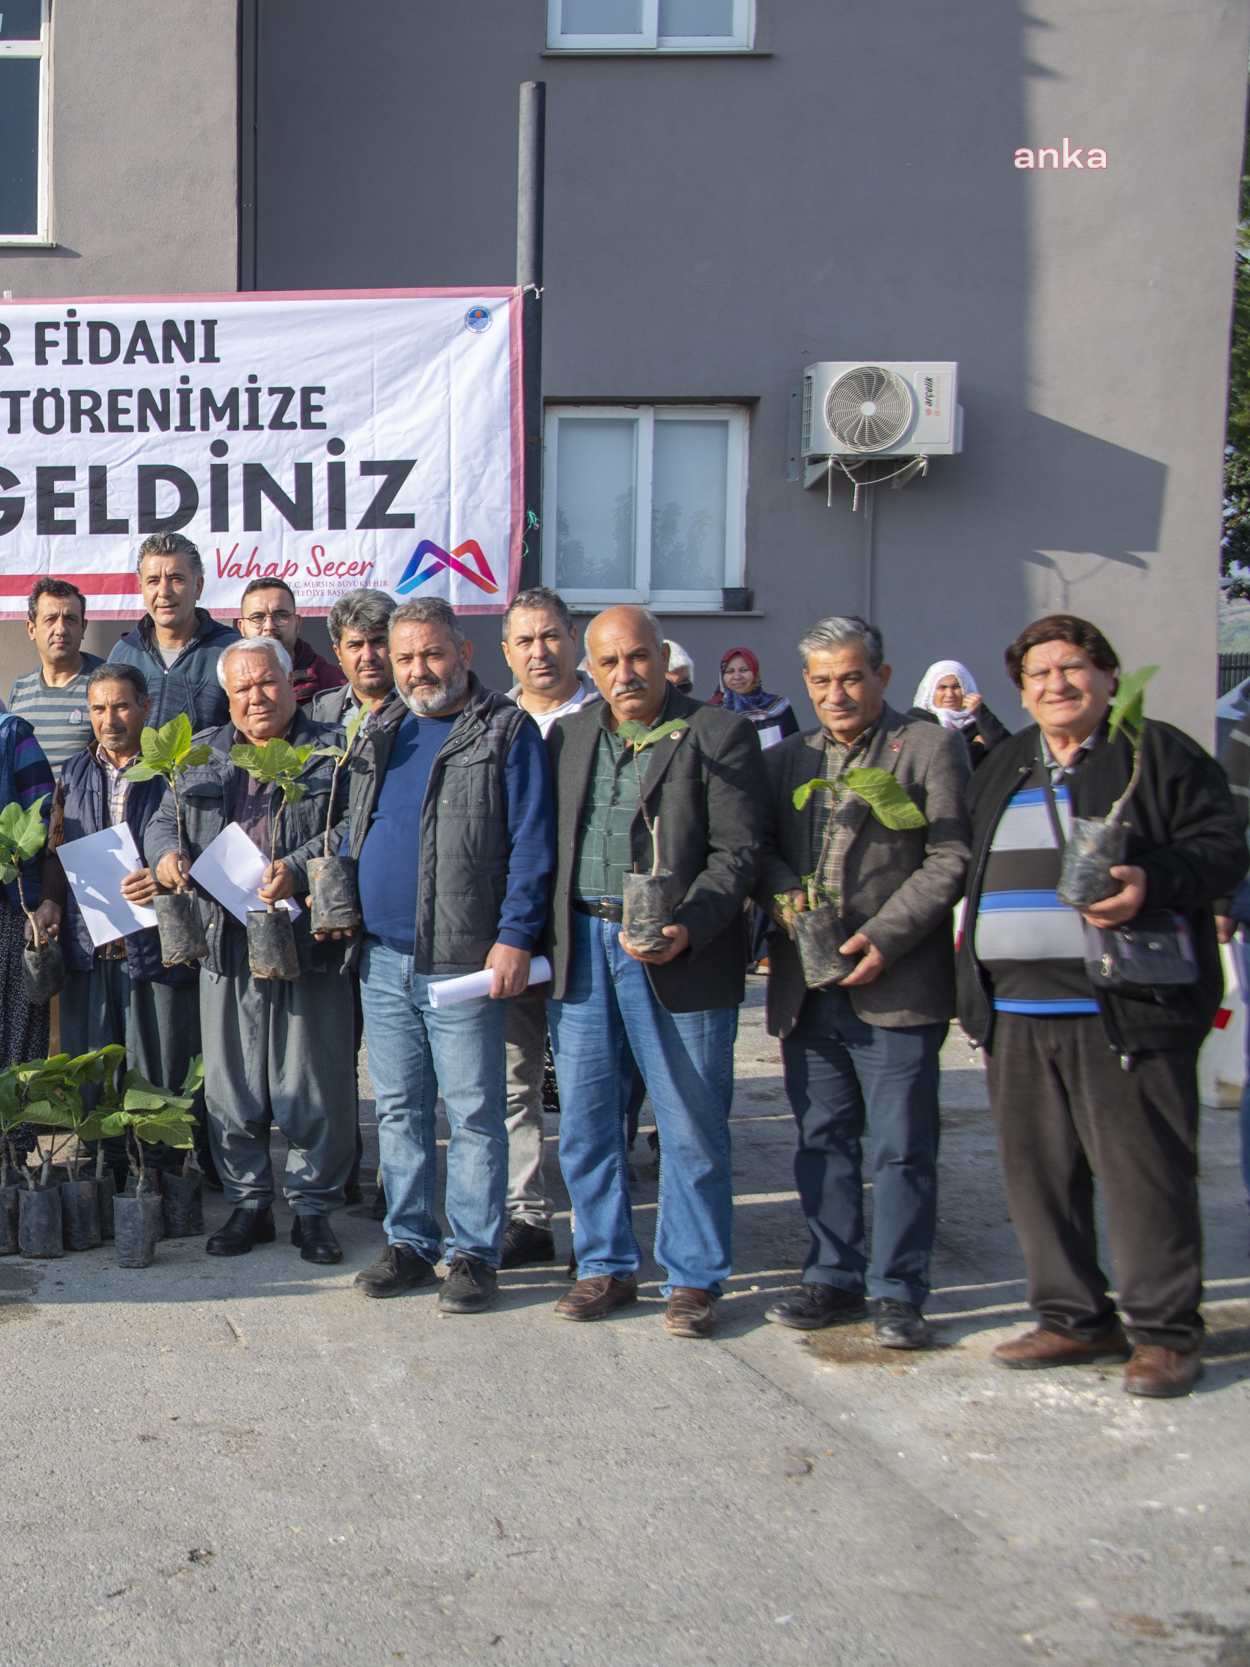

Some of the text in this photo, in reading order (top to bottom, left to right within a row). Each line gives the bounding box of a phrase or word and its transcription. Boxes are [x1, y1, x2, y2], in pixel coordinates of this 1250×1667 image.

[34, 308, 221, 366] FİDANI
[0, 373, 327, 435] TÖRENİMİZE
[216, 542, 374, 580] Vahap Seçer
[293, 589, 325, 597] ELEDİYE
[304, 580, 335, 588] MERSİN
